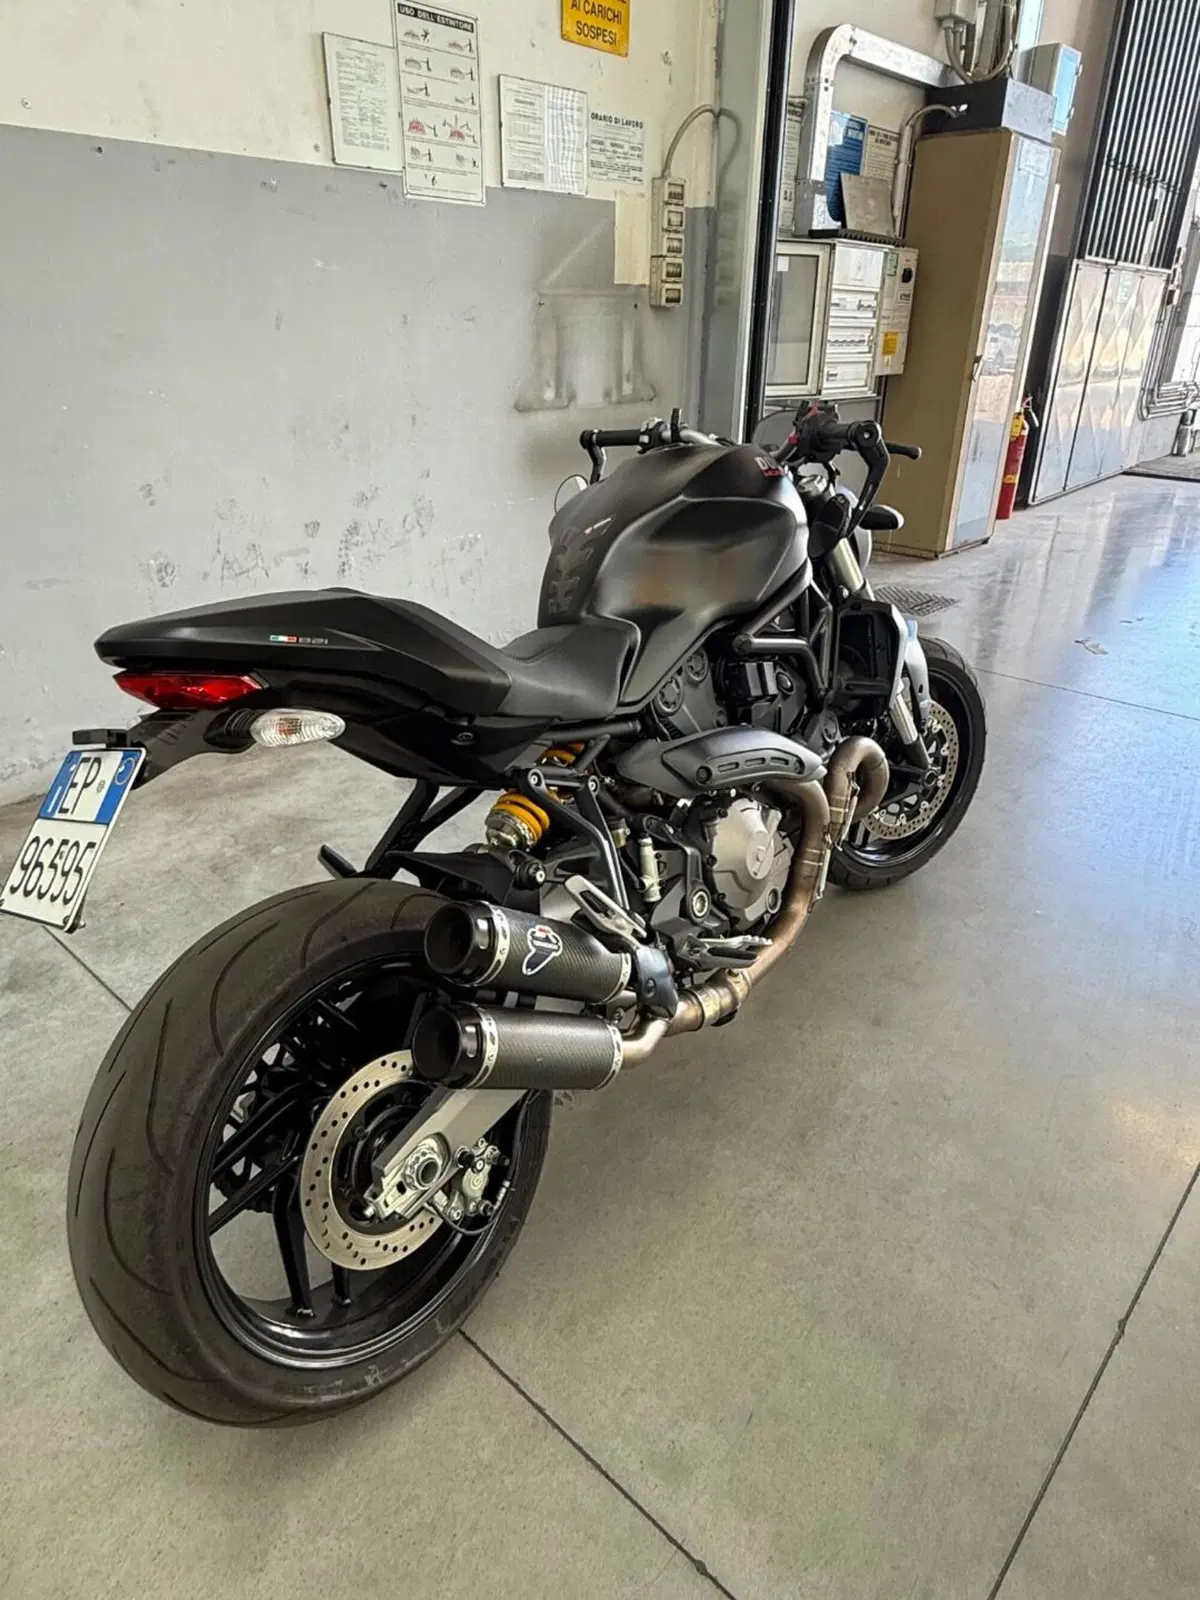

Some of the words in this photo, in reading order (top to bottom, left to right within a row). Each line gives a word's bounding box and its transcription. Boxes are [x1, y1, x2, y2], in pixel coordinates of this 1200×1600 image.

[400, 5, 415, 16] USO
[571, 0, 581, 11] AI
[583, 0, 622, 24] CARICHI
[575, 20, 617, 46] SOSPESI
[591, 112, 613, 124] ORARIO
[614, 116, 621, 124] DI
[622, 118, 643, 129] LAVORO
[57, 756, 103, 815] EP
[9, 835, 97, 905] 96595
